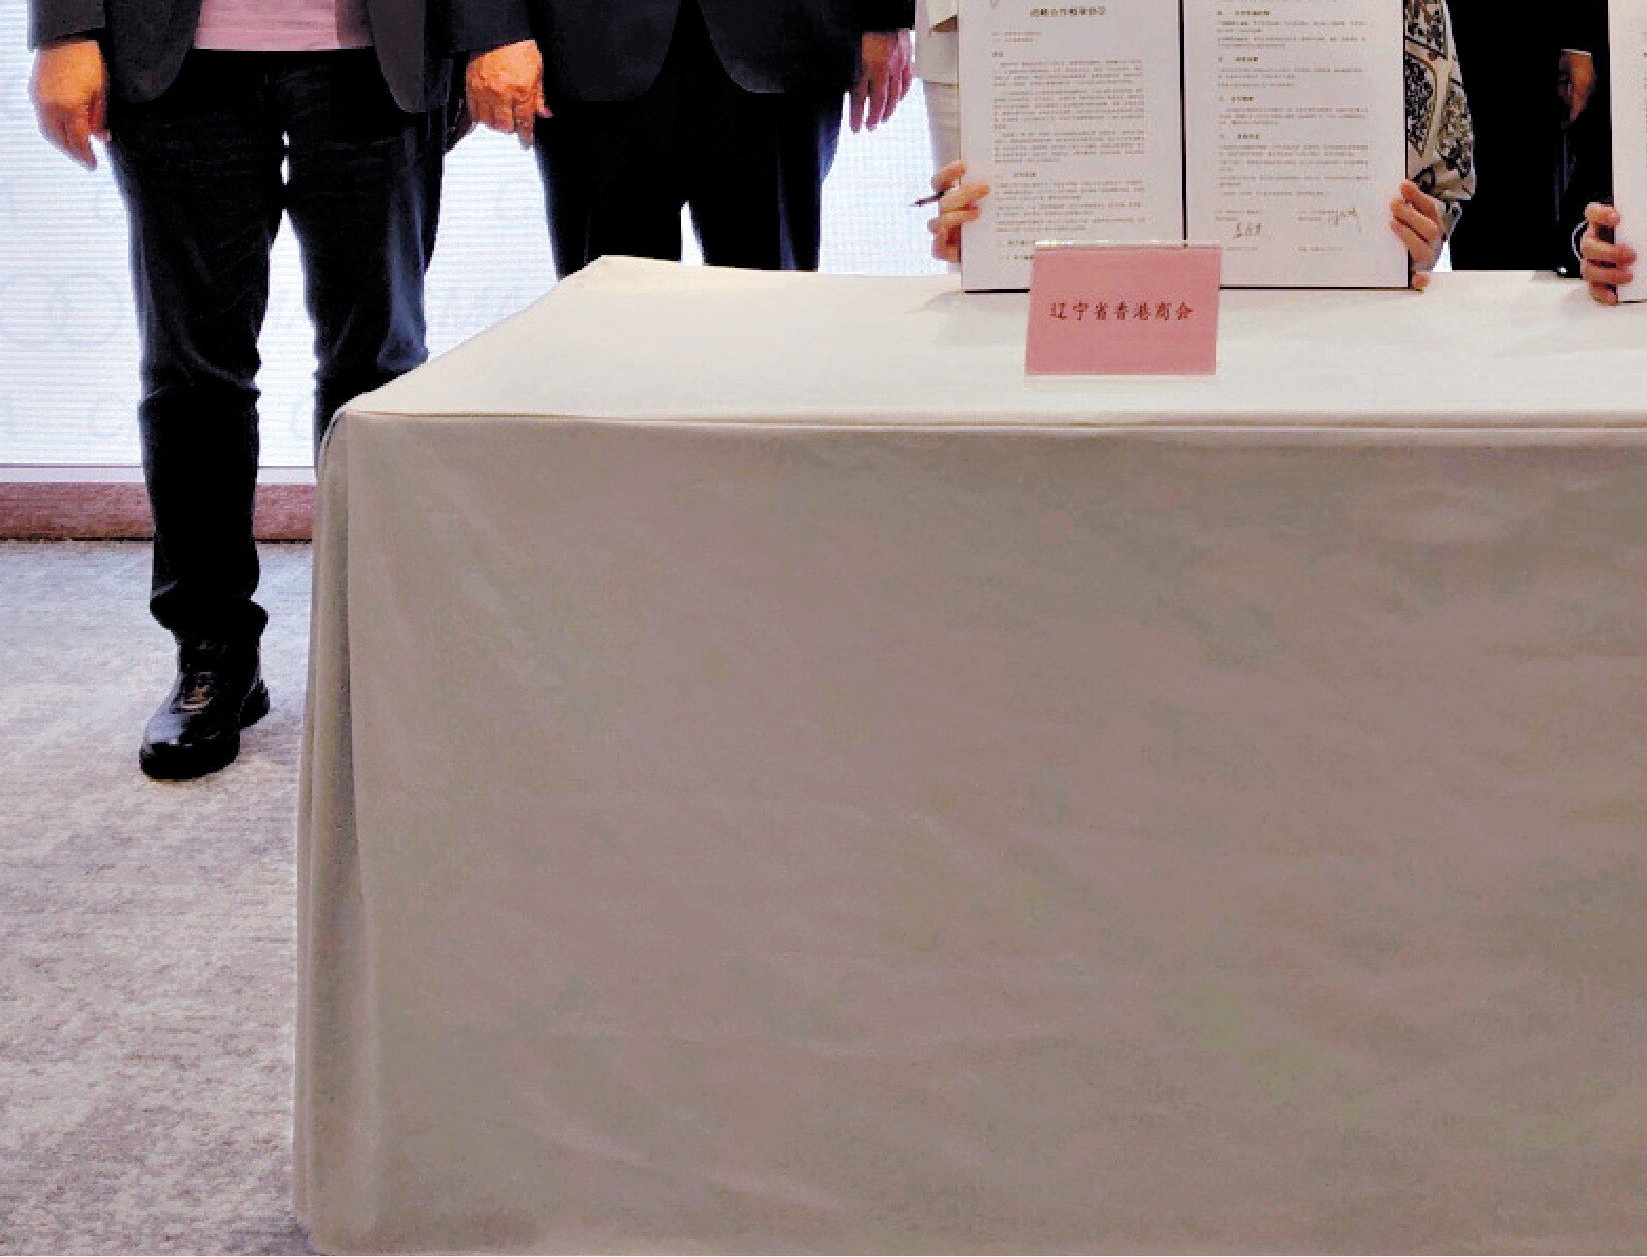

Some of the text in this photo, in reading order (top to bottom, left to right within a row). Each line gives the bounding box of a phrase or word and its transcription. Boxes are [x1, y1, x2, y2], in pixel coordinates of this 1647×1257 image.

[1049, 300, 1194, 321] 辽宁省香港商会
